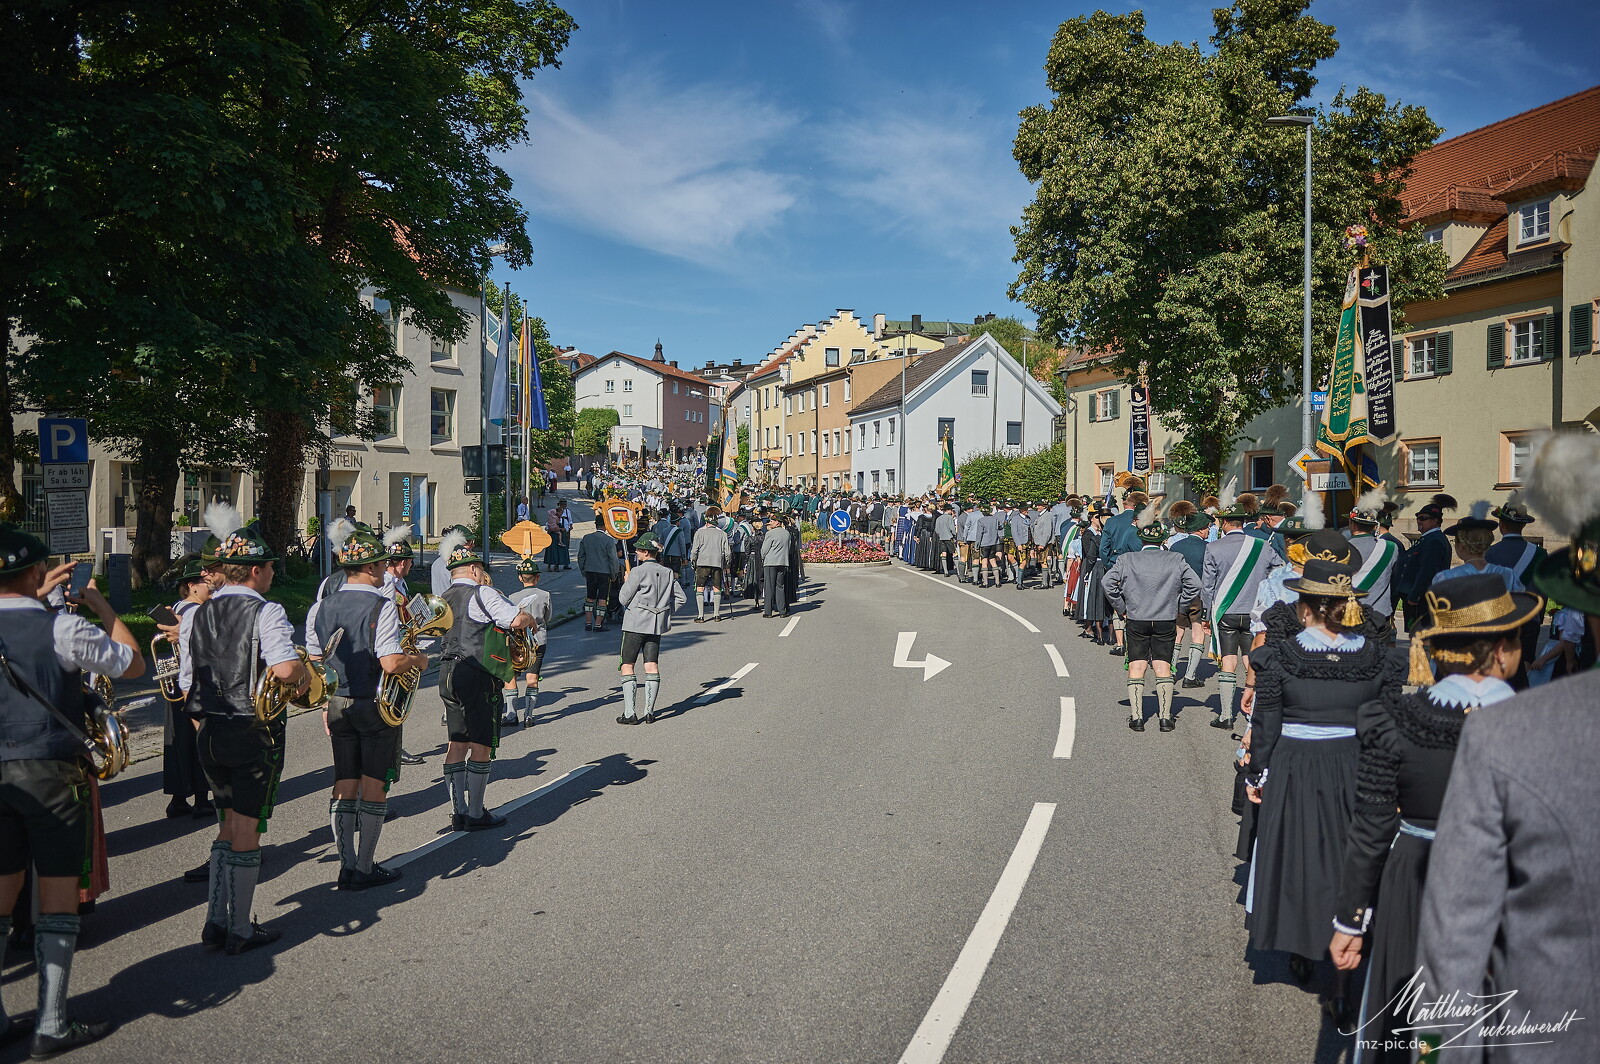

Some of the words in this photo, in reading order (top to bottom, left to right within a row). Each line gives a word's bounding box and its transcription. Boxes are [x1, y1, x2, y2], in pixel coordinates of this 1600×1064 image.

[51, 424, 76, 460] P
[47, 468, 56, 476] Fr
[59, 468, 68, 476] ab
[373, 470, 380, 486] 4
[51, 477, 60, 485] Sa
[72, 476, 82, 484] So
[1318, 475, 1346, 489] Laufen
[402, 477, 412, 517] BayernLab
